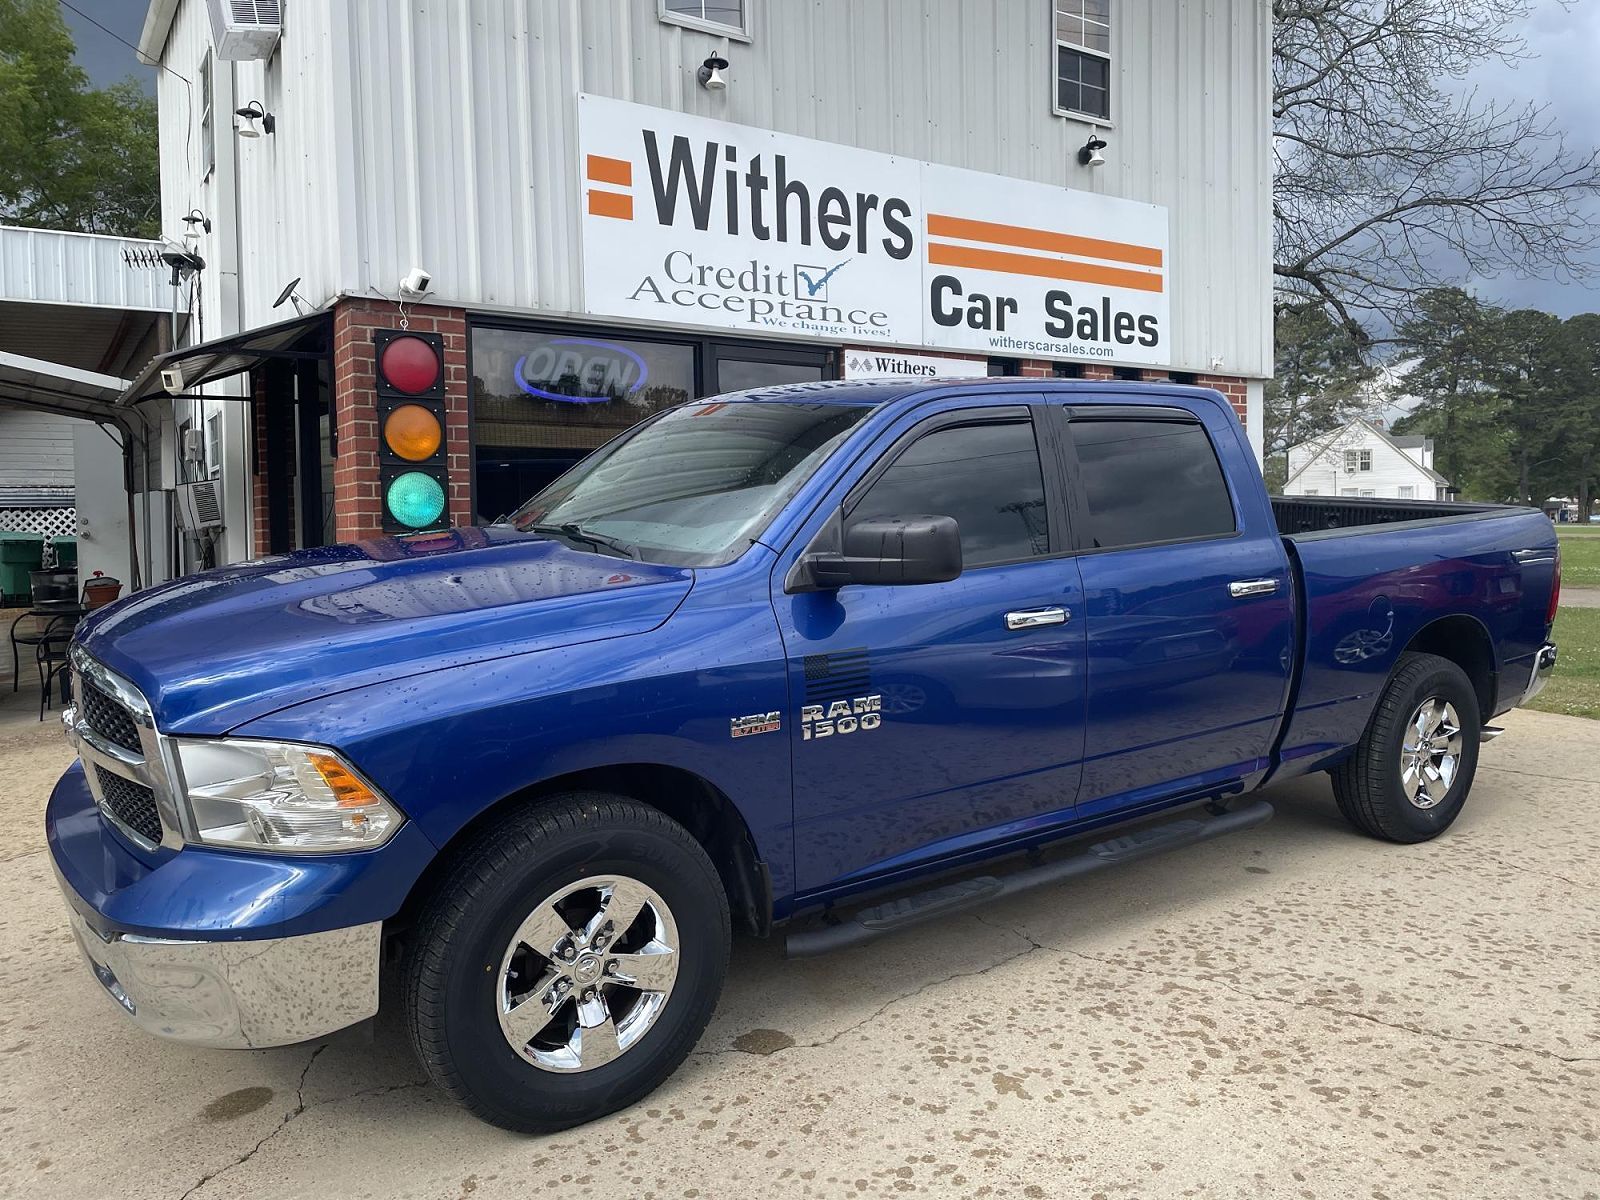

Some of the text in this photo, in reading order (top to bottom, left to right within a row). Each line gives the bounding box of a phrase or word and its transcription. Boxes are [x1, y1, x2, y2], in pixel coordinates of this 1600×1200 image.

[642, 129, 914, 261] Withers
[664, 251, 790, 297] Credit
[626, 275, 889, 327] Acceptance
[930, 274, 1159, 347] Car Sales
[762, 316, 892, 338] We change lives!
[989, 335, 1114, 358] witherscarsales.com
[524, 347, 634, 395] OPEN
[875, 357, 936, 377] Withers
[730, 711, 781, 728] HEMI
[801, 695, 881, 722] RAM
[801, 713, 881, 741] 1500
